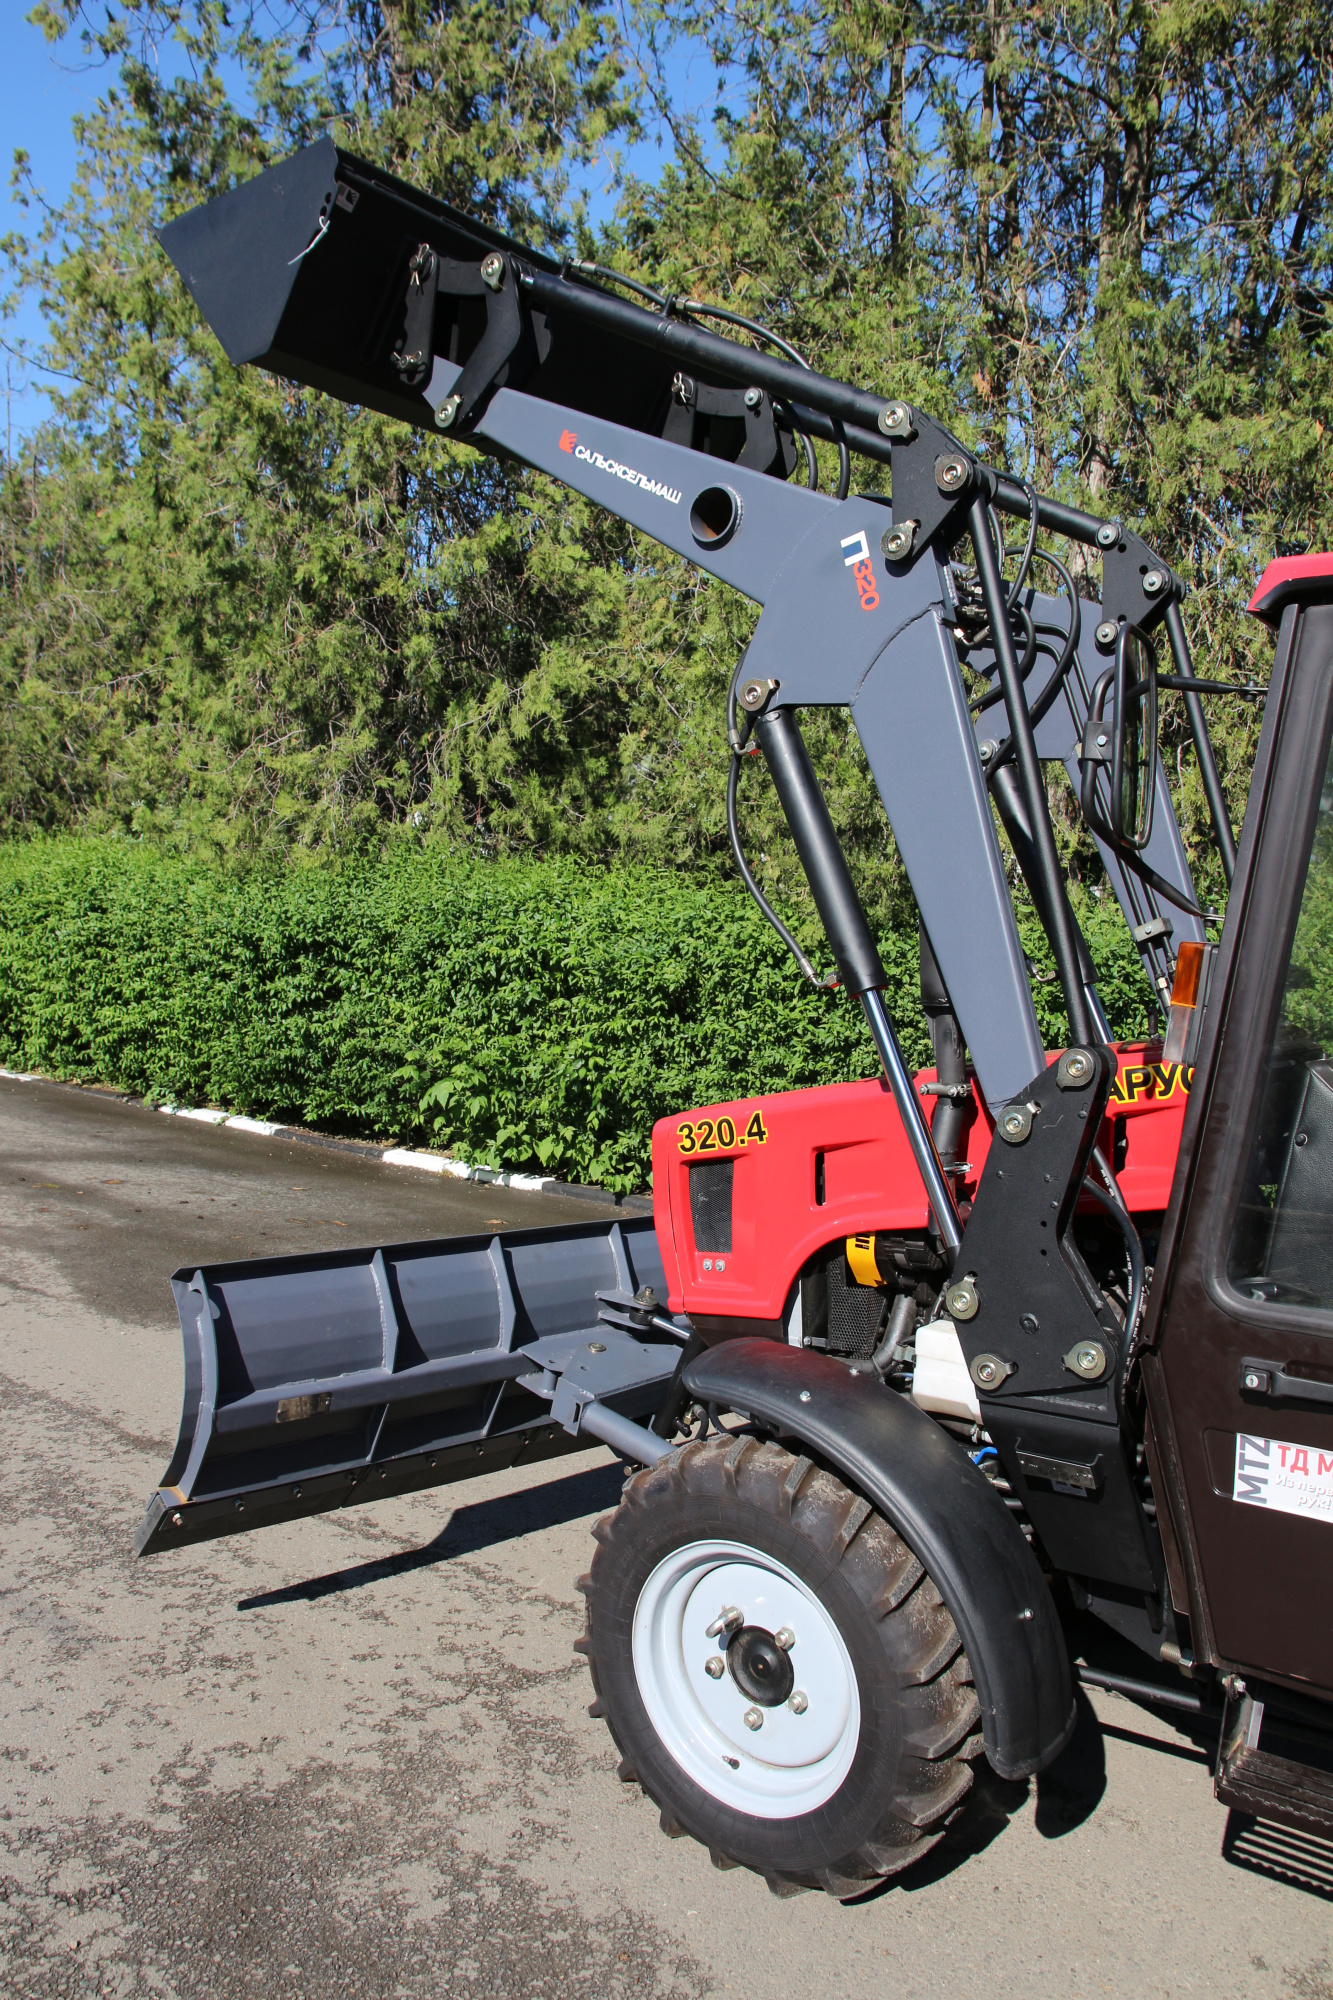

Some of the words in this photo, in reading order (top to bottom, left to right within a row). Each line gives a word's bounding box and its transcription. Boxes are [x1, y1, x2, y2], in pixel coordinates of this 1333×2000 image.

[575, 445, 682, 504] САЛЬСКСЕЛЬМАШ
[677, 1110, 768, 1154] 320.4
[1236, 1434, 1270, 1505] MTZ
[1277, 1444, 1309, 1477] ТД
[1275, 1473, 1295, 1489] Из
[1296, 1494, 1332, 1511] рук!
